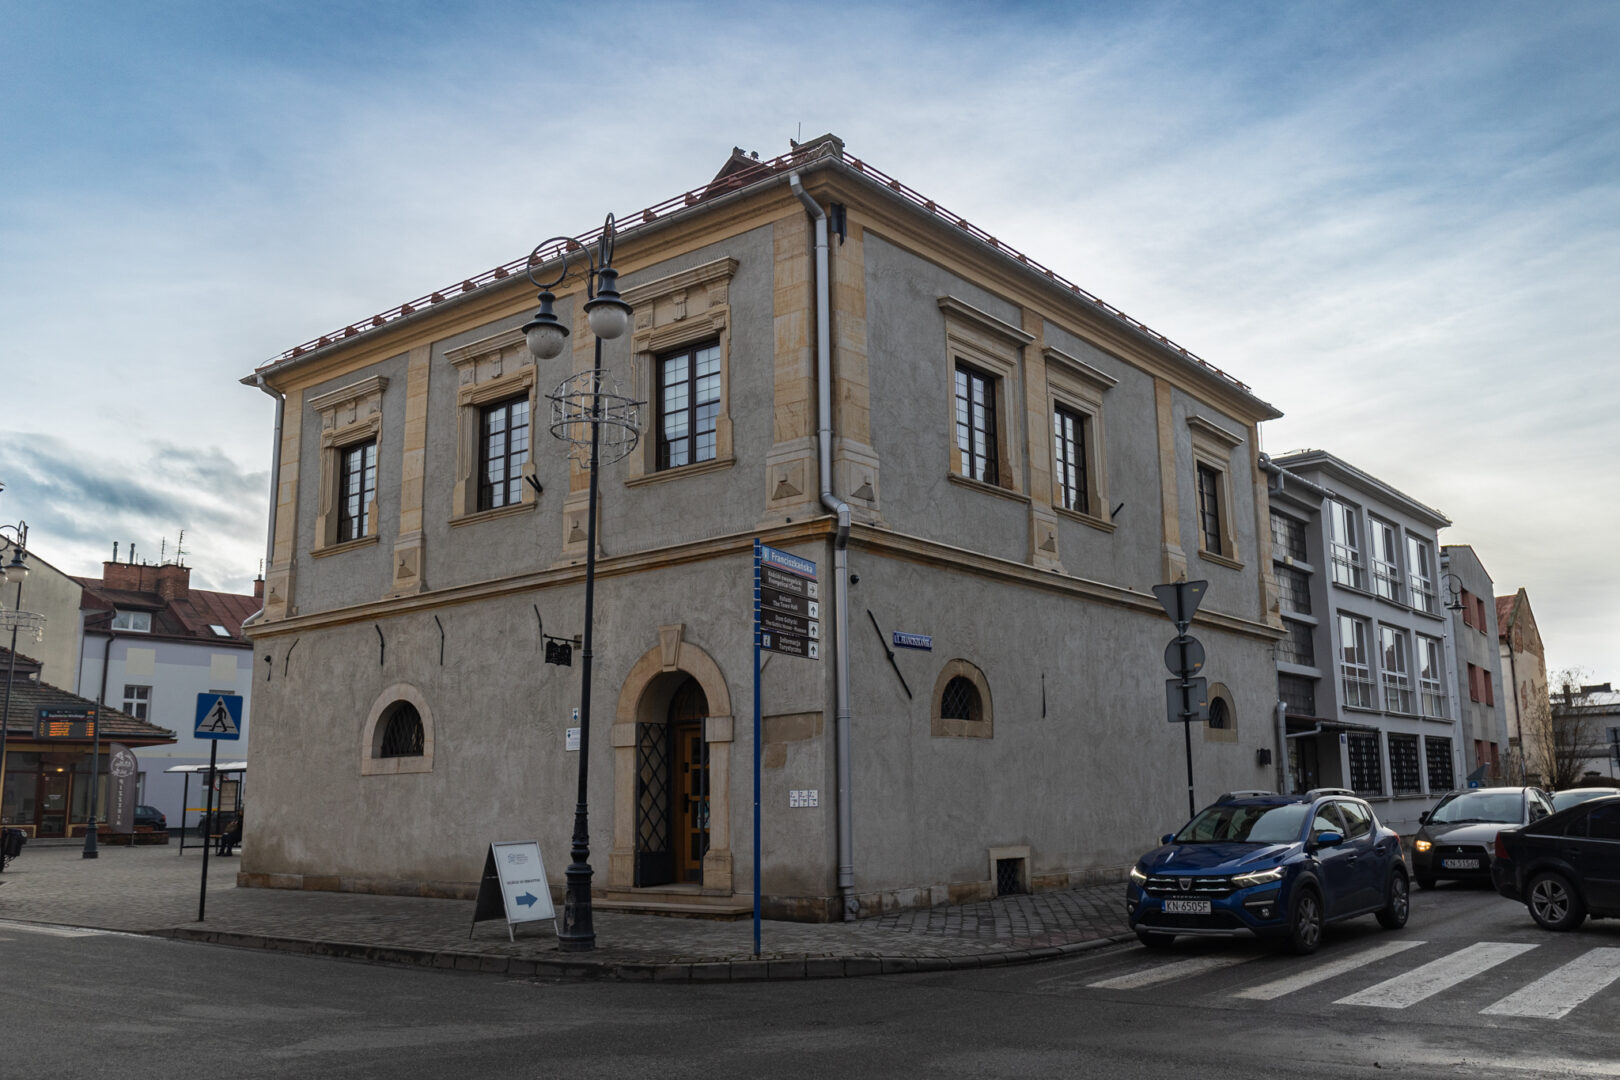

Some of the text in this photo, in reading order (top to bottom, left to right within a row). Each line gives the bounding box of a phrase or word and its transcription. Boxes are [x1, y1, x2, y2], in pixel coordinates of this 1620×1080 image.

[771, 551, 813, 573] Franciszkańska
[1167, 902, 1208, 912] KN 6505F
